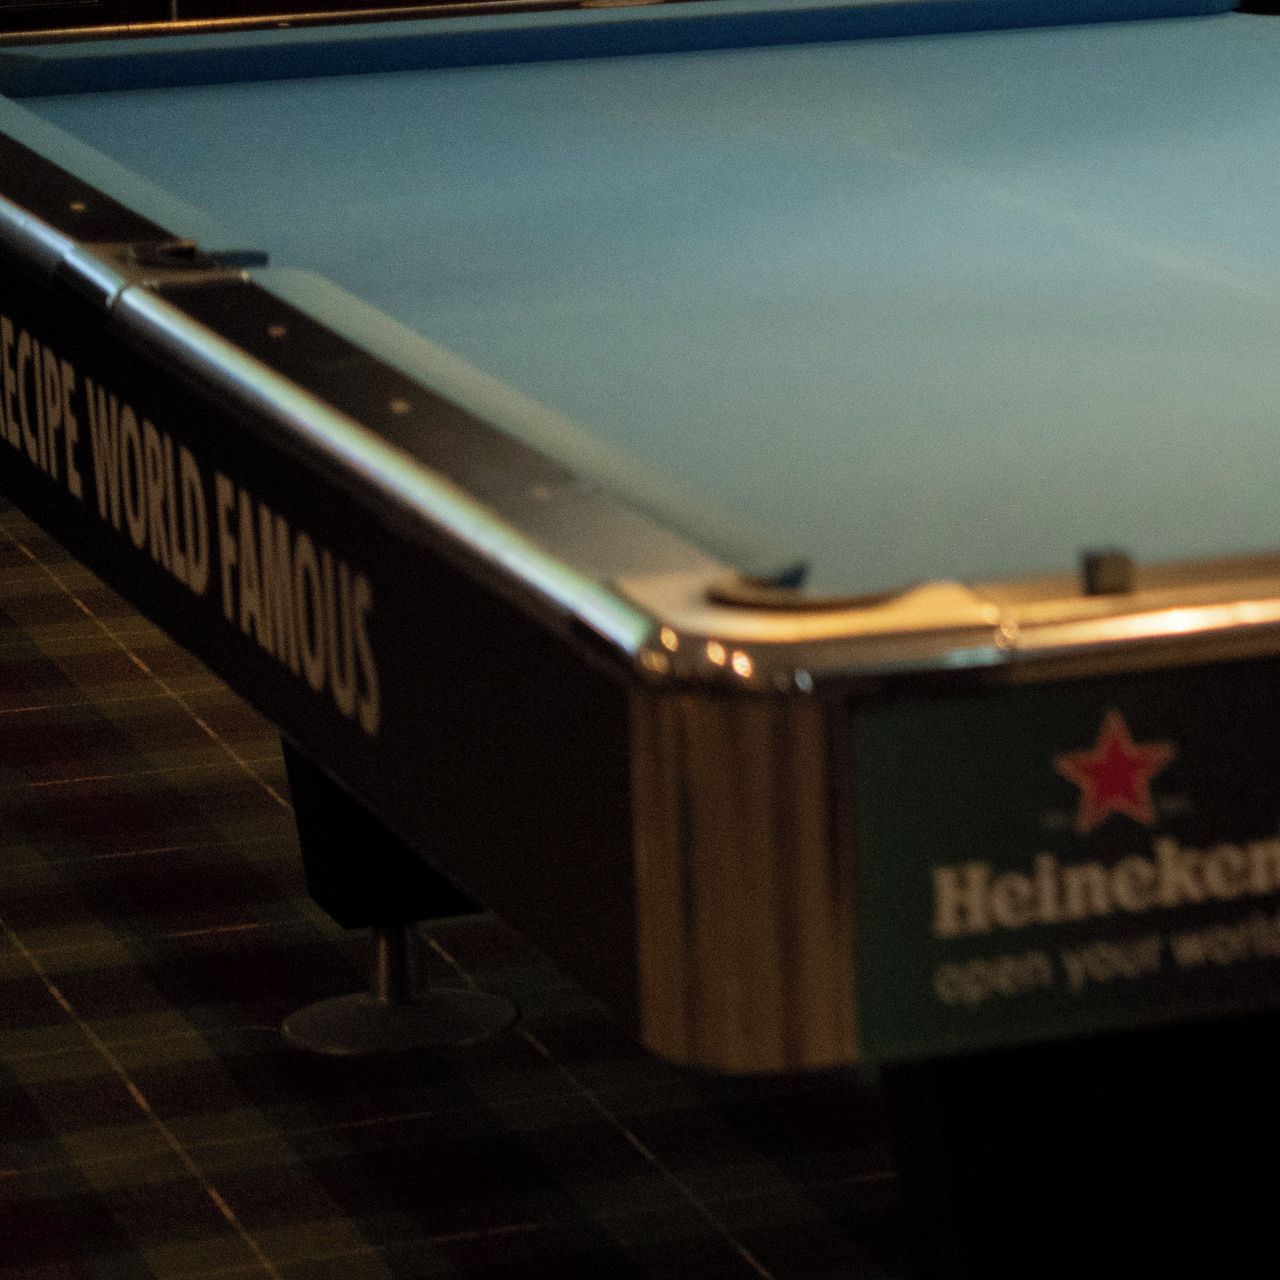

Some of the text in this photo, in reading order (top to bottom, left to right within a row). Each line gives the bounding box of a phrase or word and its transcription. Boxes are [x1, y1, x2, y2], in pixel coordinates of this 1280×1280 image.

[0, 312, 382, 737] ECIPE WORLD FAMOUS
[932, 948, 1054, 1009] open
[1059, 934, 1166, 994] your
